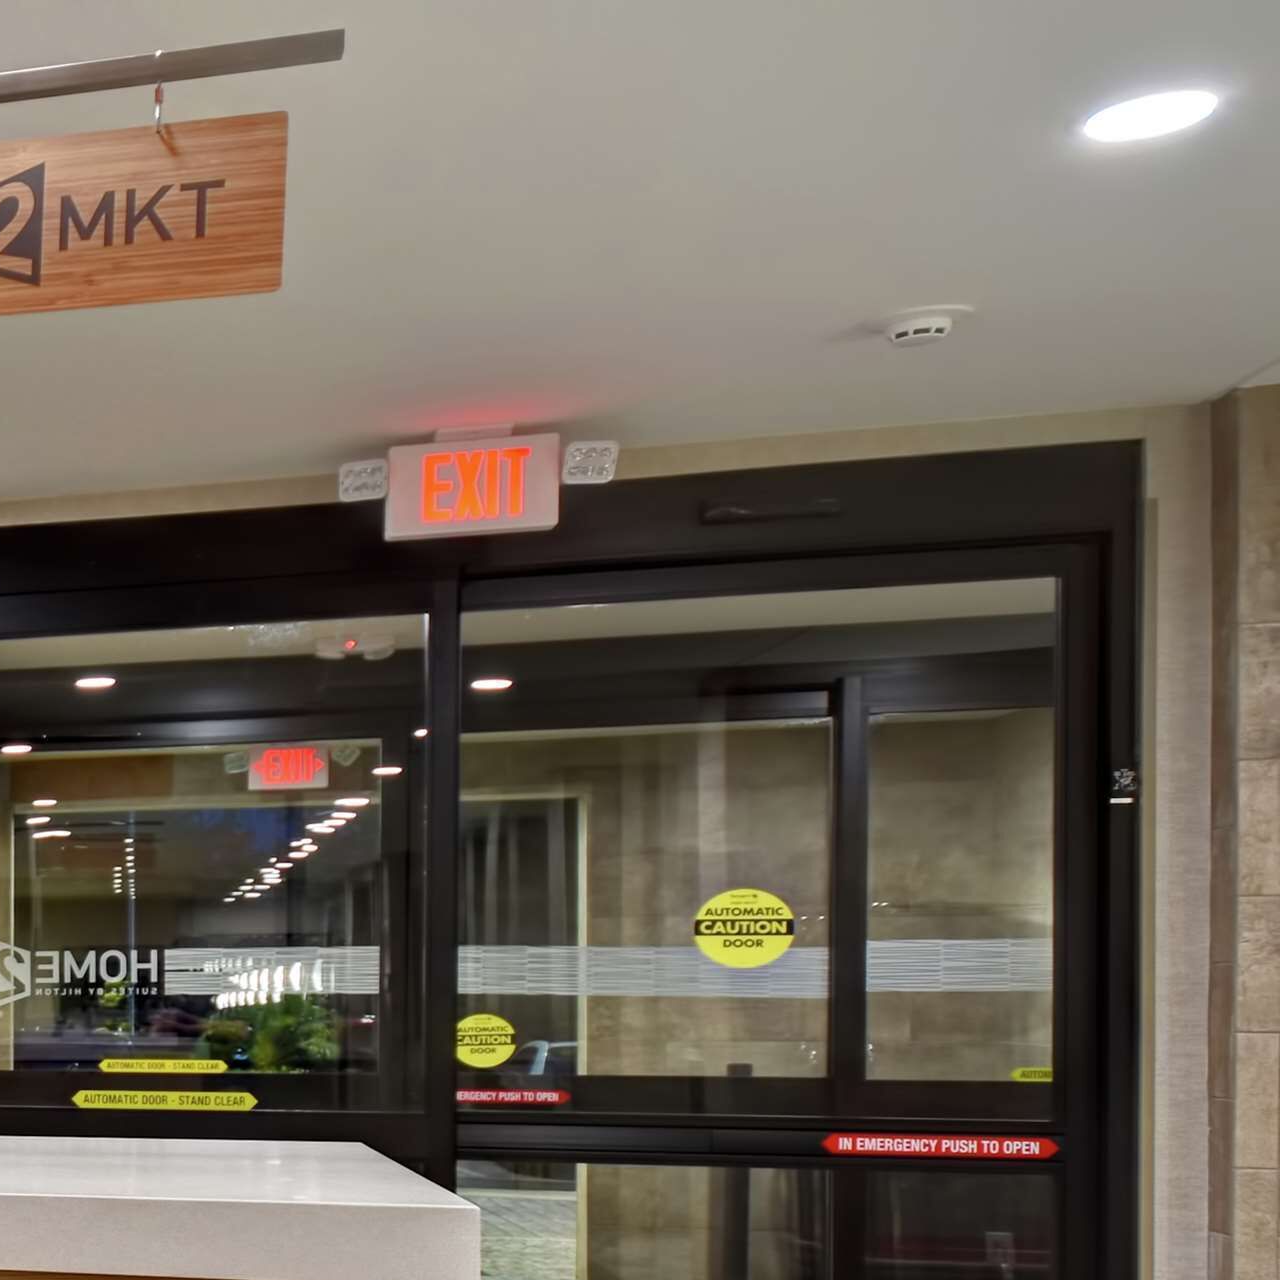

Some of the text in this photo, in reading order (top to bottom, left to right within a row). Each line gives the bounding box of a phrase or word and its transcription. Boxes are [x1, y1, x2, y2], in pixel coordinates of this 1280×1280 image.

[58, 178, 226, 251] MKT
[421, 446, 531, 523] EXIT
[705, 907, 784, 916] AUTOMATIC
[700, 921, 787, 934] CAUTION
[723, 939, 764, 947] DOOR
[84, 1094, 245, 1105] AUTOMATIC DOOR STAND CLEAR
[499, 1092, 520, 1101] PUSH
[523, 1092, 534, 1101] TO
[536, 1092, 559, 1101] OPEN
[839, 1138, 1039, 1154] IN EMERGENCY PUSH TO OPEN
